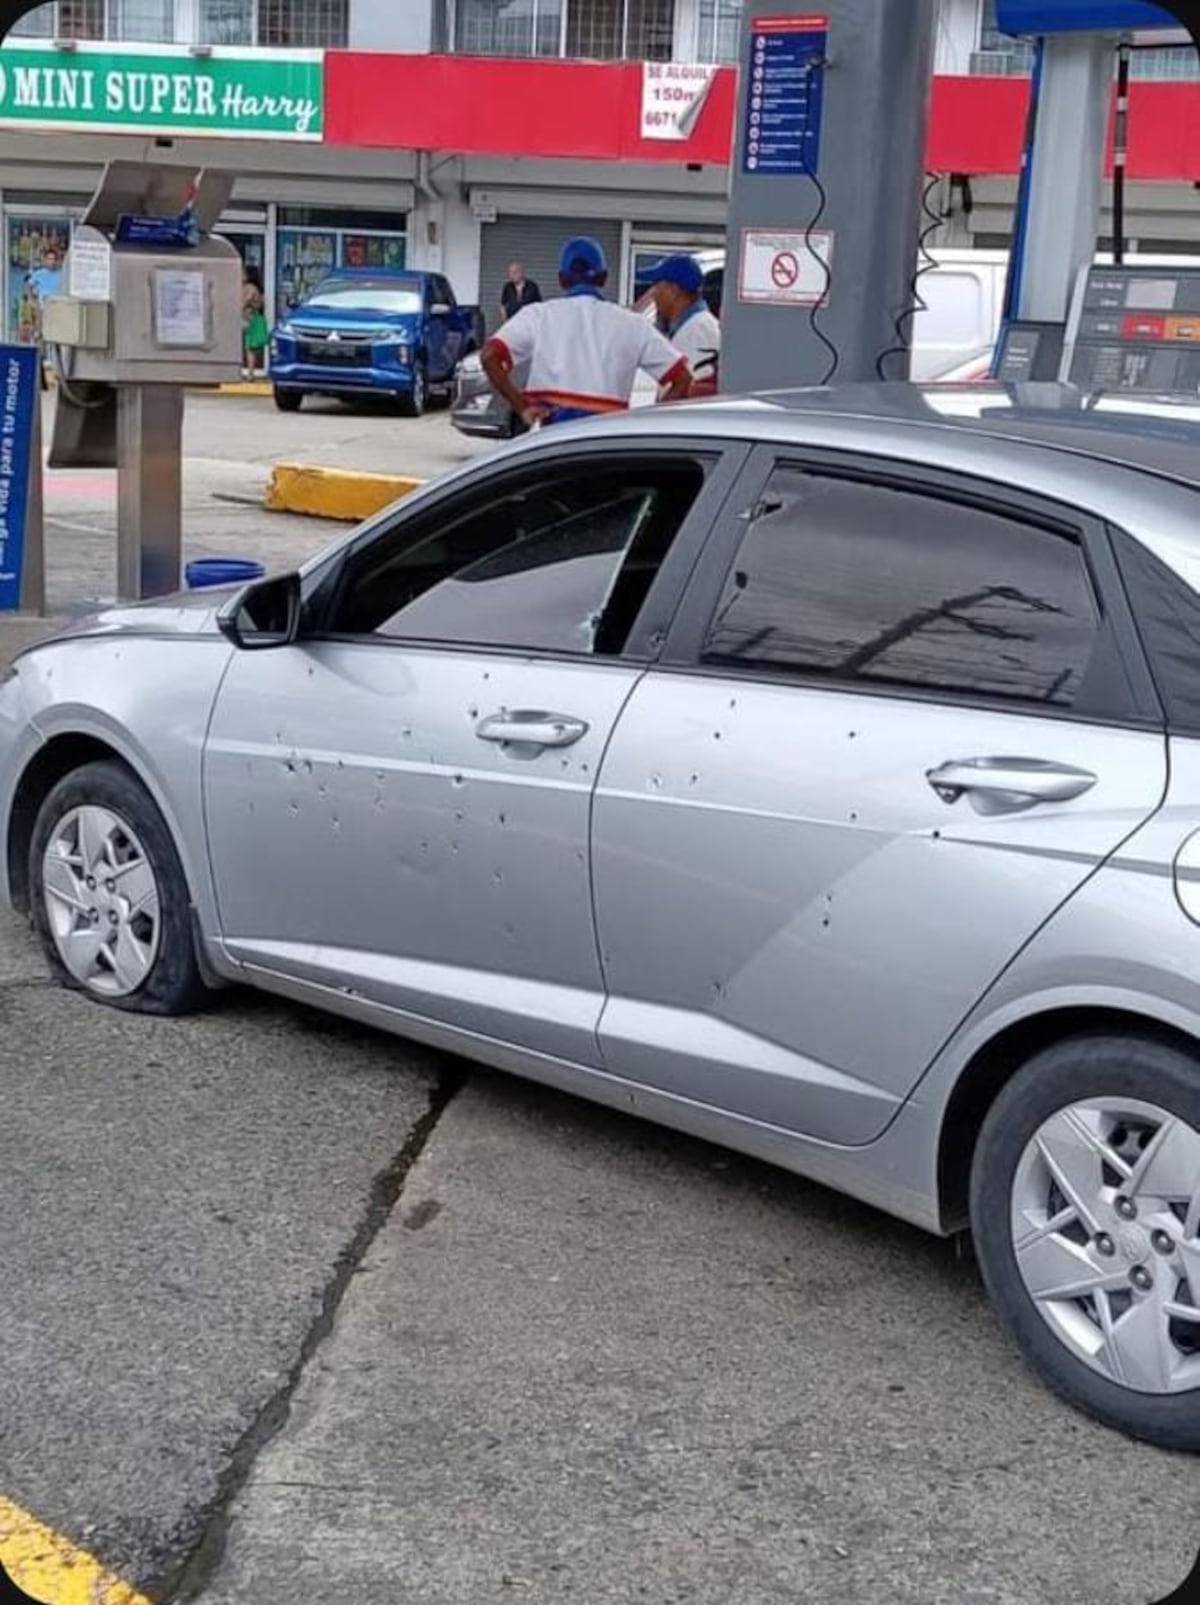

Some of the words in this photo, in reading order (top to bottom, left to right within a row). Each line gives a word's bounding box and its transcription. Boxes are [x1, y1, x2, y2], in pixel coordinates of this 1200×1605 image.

[648, 66, 662, 79] SE
[665, 66, 715, 80] ALQUIL
[12, 66, 95, 110] MINI
[105, 71, 216, 116] SUPER
[221, 83, 319, 133] Harry
[6, 357, 20, 412] motor
[2, 414, 15, 433] tu
[0, 438, 14, 475] para
